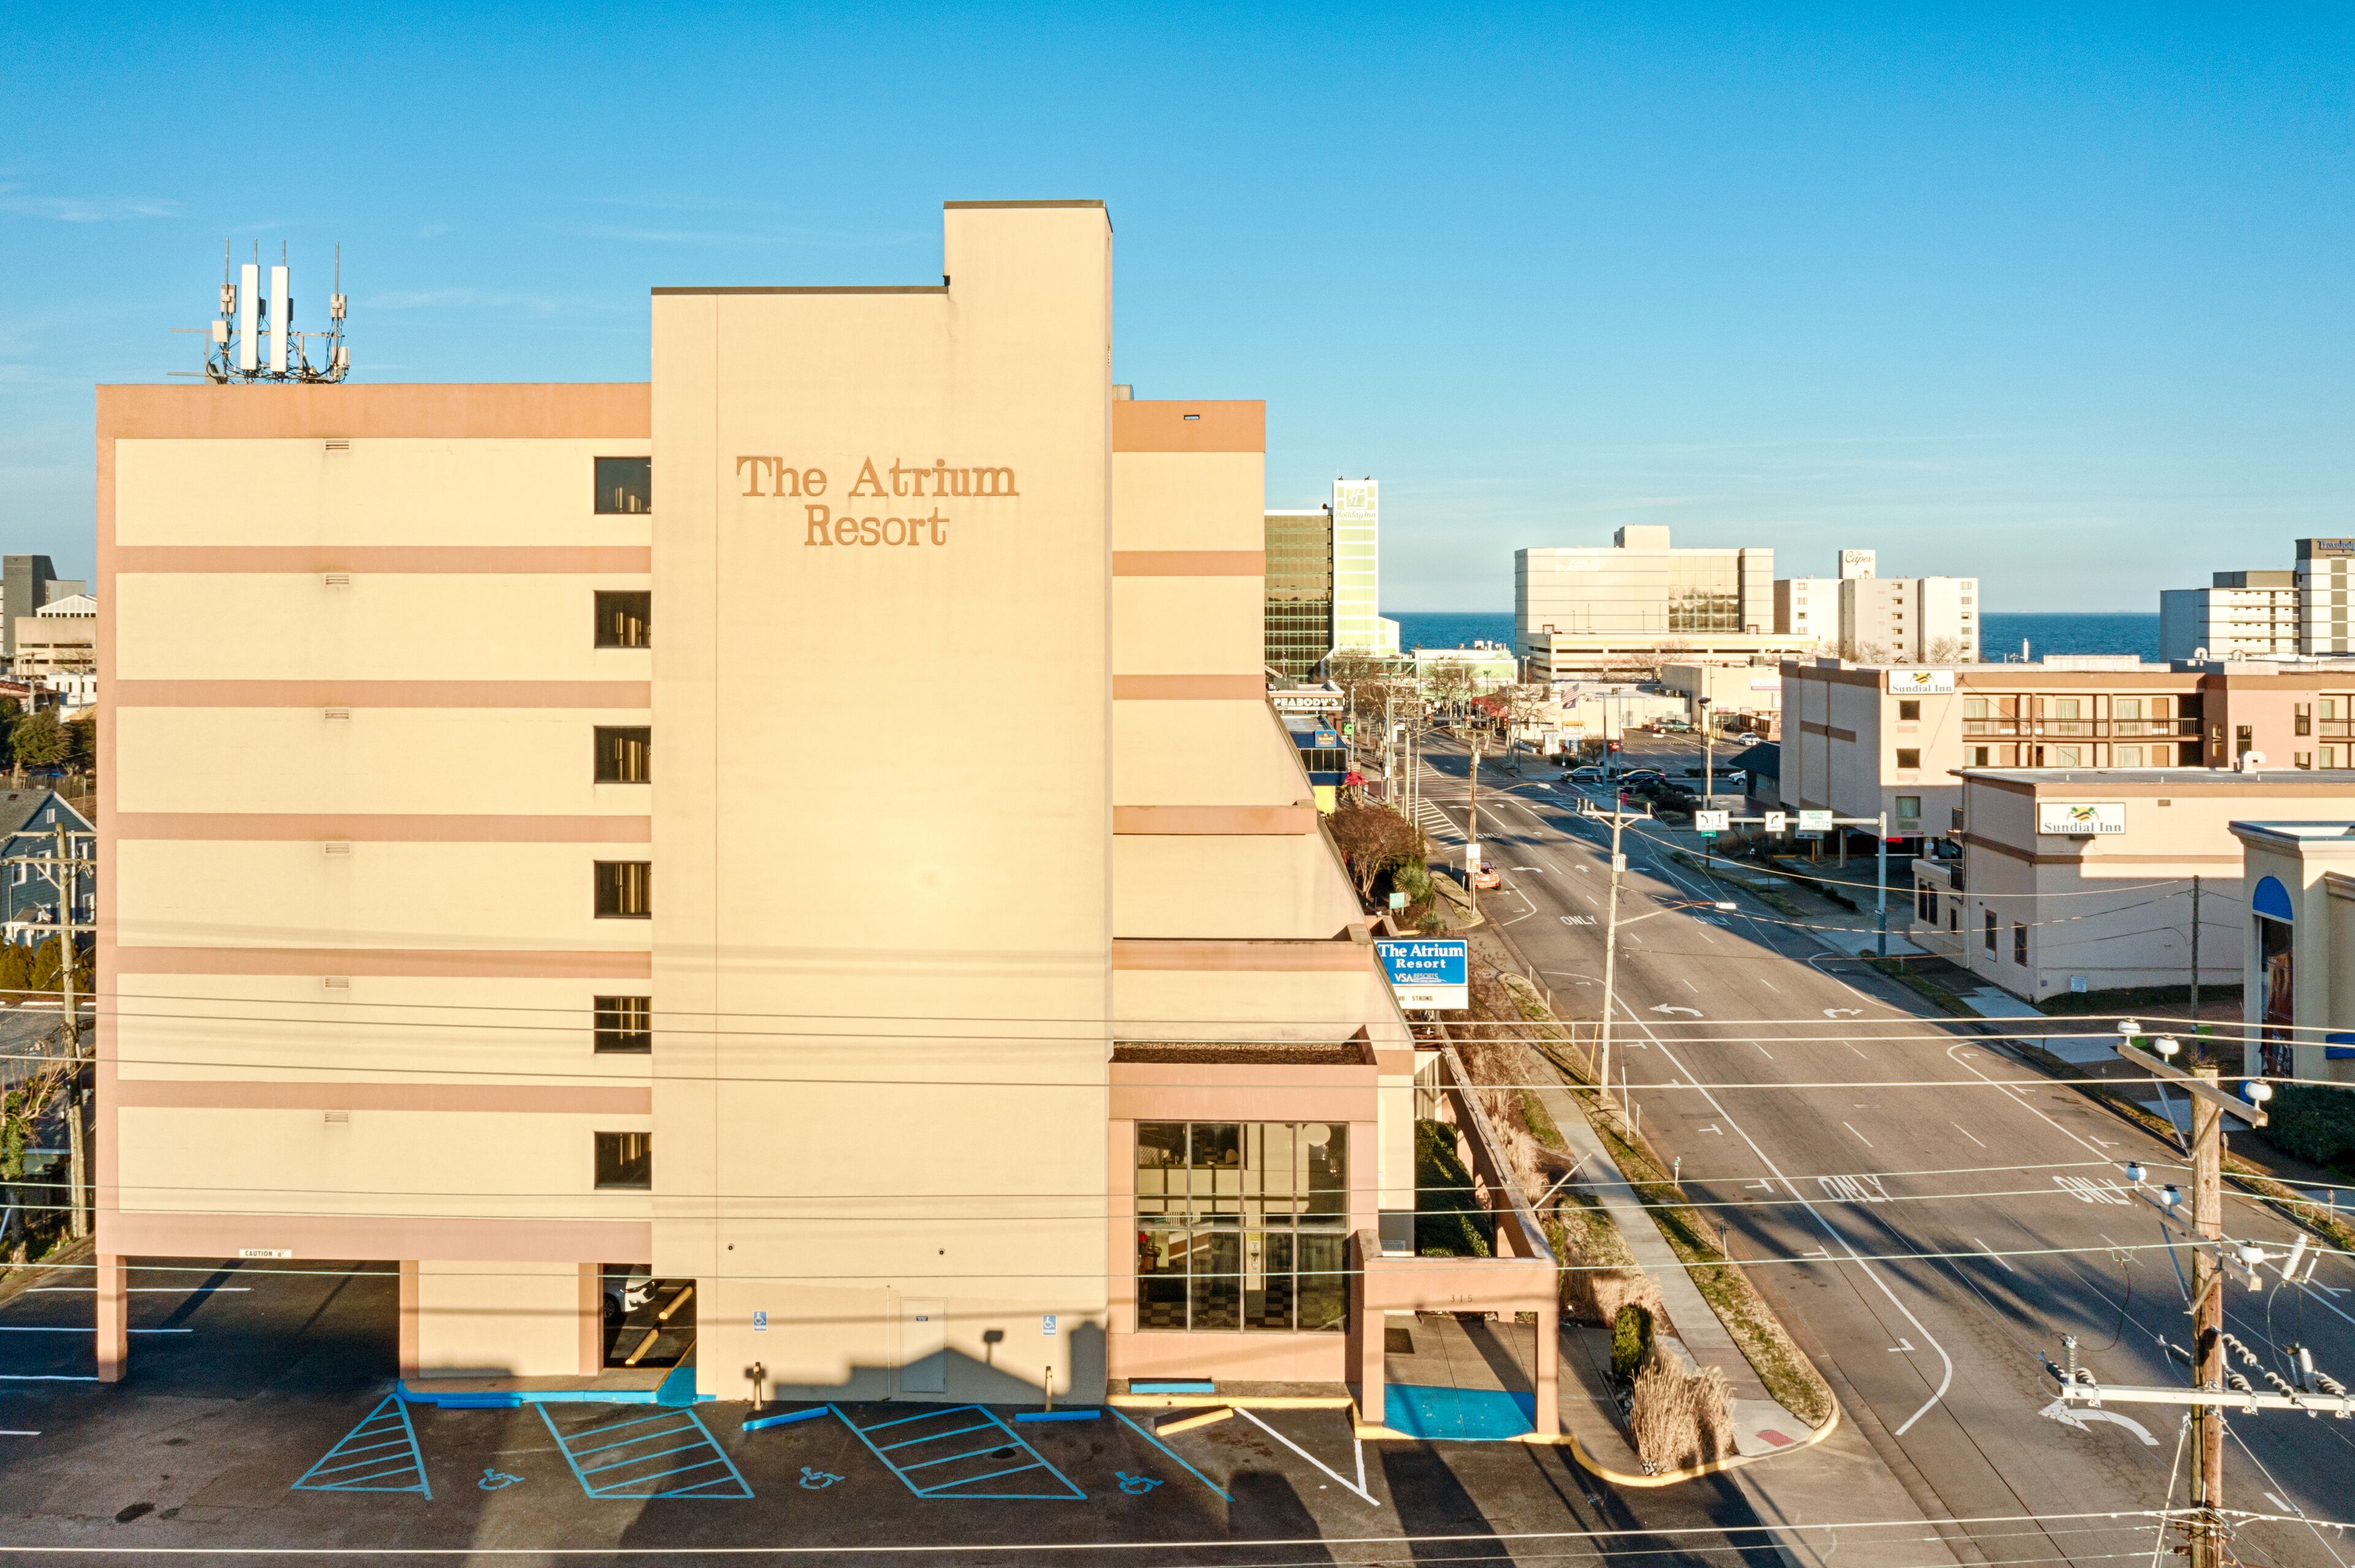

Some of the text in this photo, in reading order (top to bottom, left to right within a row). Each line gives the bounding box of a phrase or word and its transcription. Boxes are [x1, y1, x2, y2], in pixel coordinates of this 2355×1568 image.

[736, 456, 1019, 496] The Atrium
[1336, 511, 1363, 520] Holiday
[804, 504, 949, 546] Resort
[1845, 551, 1874, 566] Capes
[1892, 684, 1931, 692] Sundial
[1273, 697, 1338, 706] PEABODY'S
[2044, 822, 2121, 832] Sundial Inn
[1560, 916, 1598, 925] ONLY
[1692, 916, 1733, 925] ONLY
[1378, 944, 1464, 957] The Atrium
[1396, 958, 1446, 968] Resort
[1395, 973, 1413, 982] VSA
[1818, 1175, 1894, 1203] ONLY
[2052, 1176, 2133, 1205] ONLY
